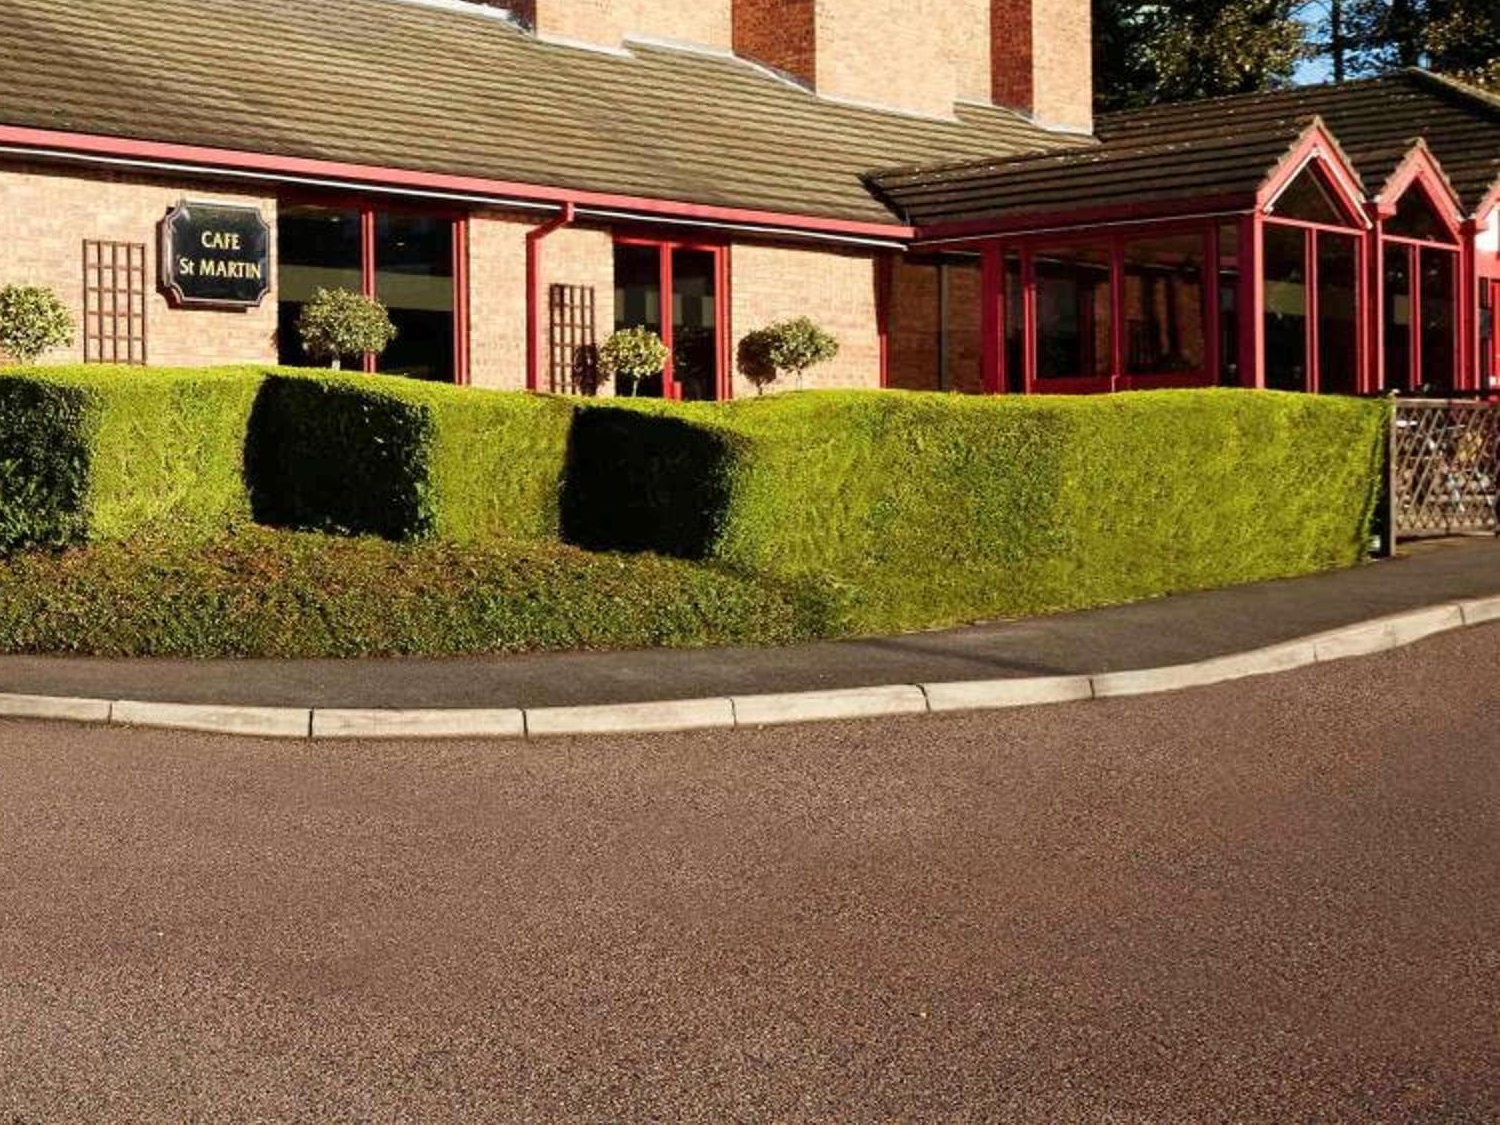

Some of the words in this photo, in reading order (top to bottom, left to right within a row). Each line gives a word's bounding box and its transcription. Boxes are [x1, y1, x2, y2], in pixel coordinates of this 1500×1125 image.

[201, 230, 241, 250] CAFE
[179, 257, 195, 275] St
[199, 258, 262, 280] MARTIN
